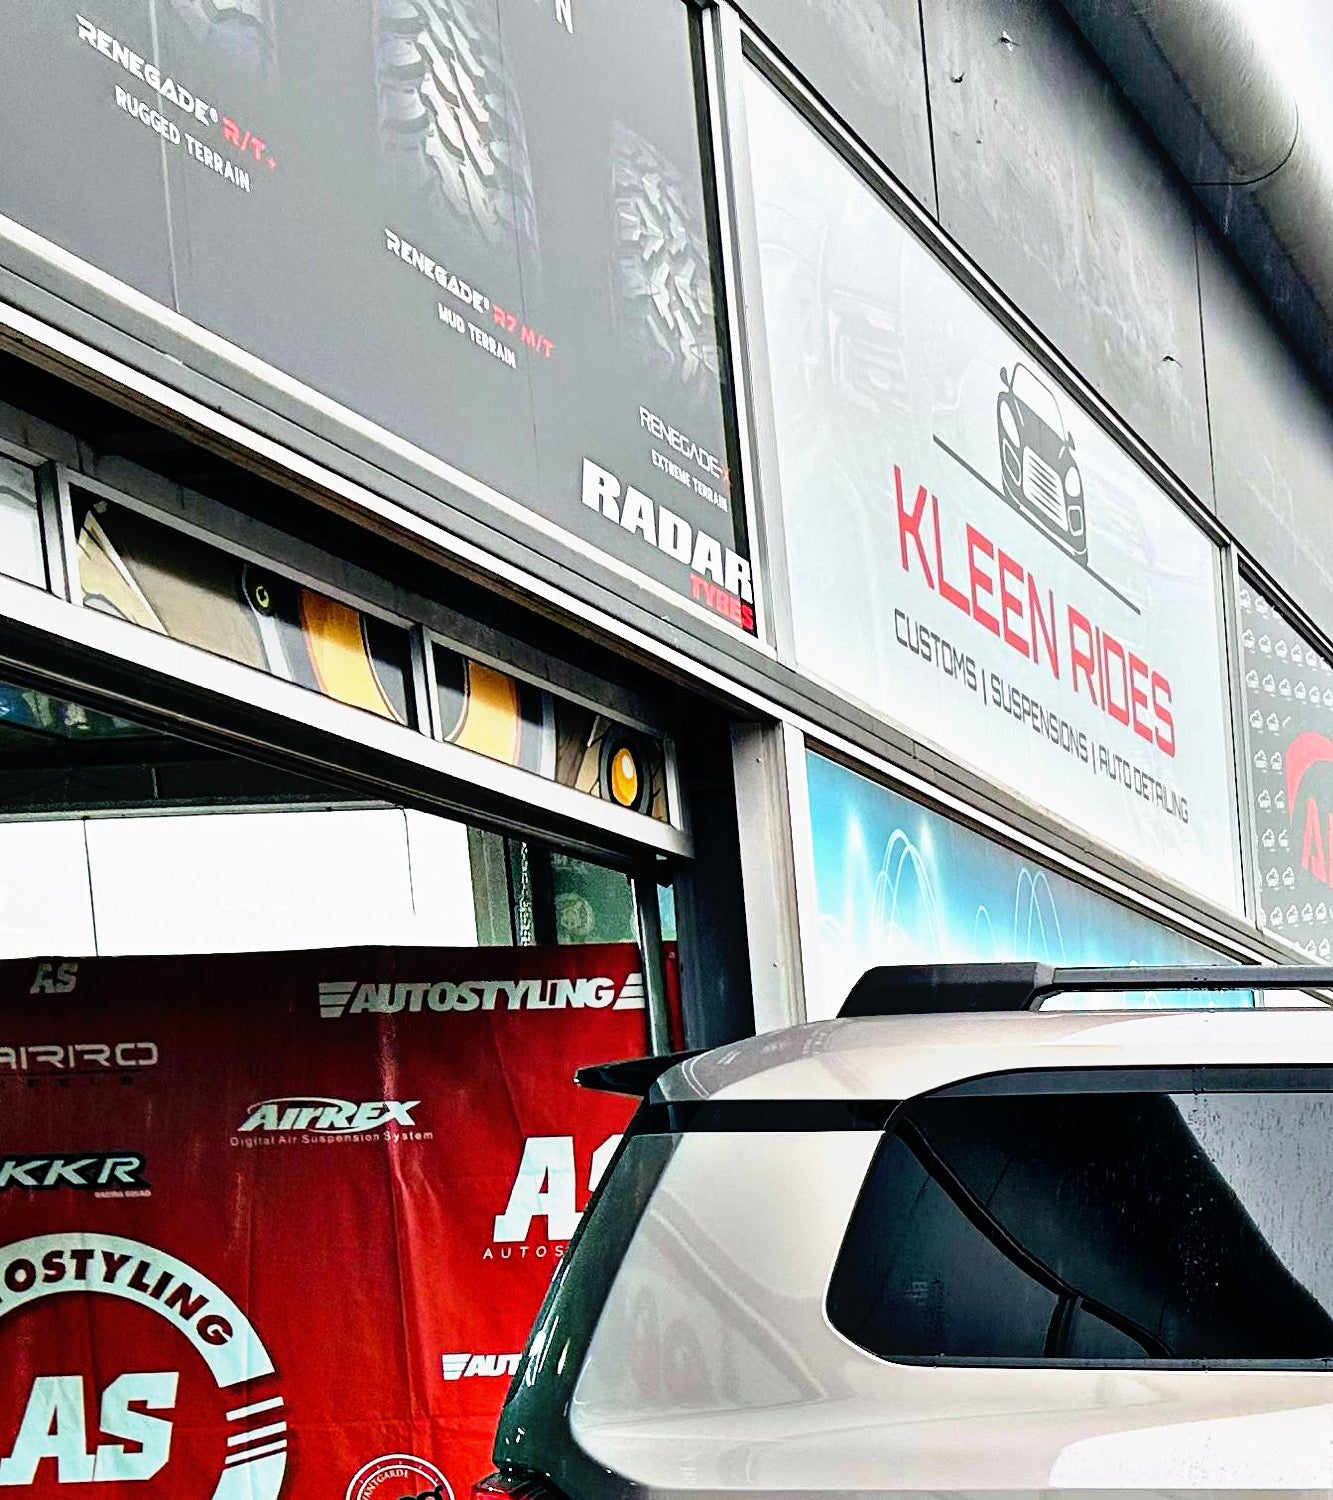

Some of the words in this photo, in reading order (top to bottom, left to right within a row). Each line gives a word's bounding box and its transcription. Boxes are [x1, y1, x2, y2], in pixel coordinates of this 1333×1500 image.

[114, 84, 181, 146] RUGGED
[184, 132, 251, 193] TERRAIN
[437, 302, 466, 334] MUD
[467, 321, 517, 370] TERRAIN
[492, 302, 519, 334] R7
[520, 322, 554, 359] M/T
[651, 449, 690, 488] EXTREME
[691, 476, 729, 513] TERRAIN
[581, 457, 754, 605] RADAR
[894, 463, 1060, 681] KLEEN
[1067, 603, 1176, 759] RIDES
[894, 607, 978, 693] CUSTOMS
[990, 673, 1089, 764] SUSPENSIONS
[1099, 744, 1132, 790] AUTO
[1134, 762, 1189, 824] DETAILING
[30, 963, 78, 994] AS
[349, 978, 614, 1015] AUTOSTYLING
[0, 1157, 140, 1187] KKR
[230, 1136, 275, 1148] Digital
[278, 1135, 297, 1145] Air
[301, 1133, 380, 1145] Suspension
[383, 1131, 434, 1143] System
[0, 1371, 180, 1486] AS
